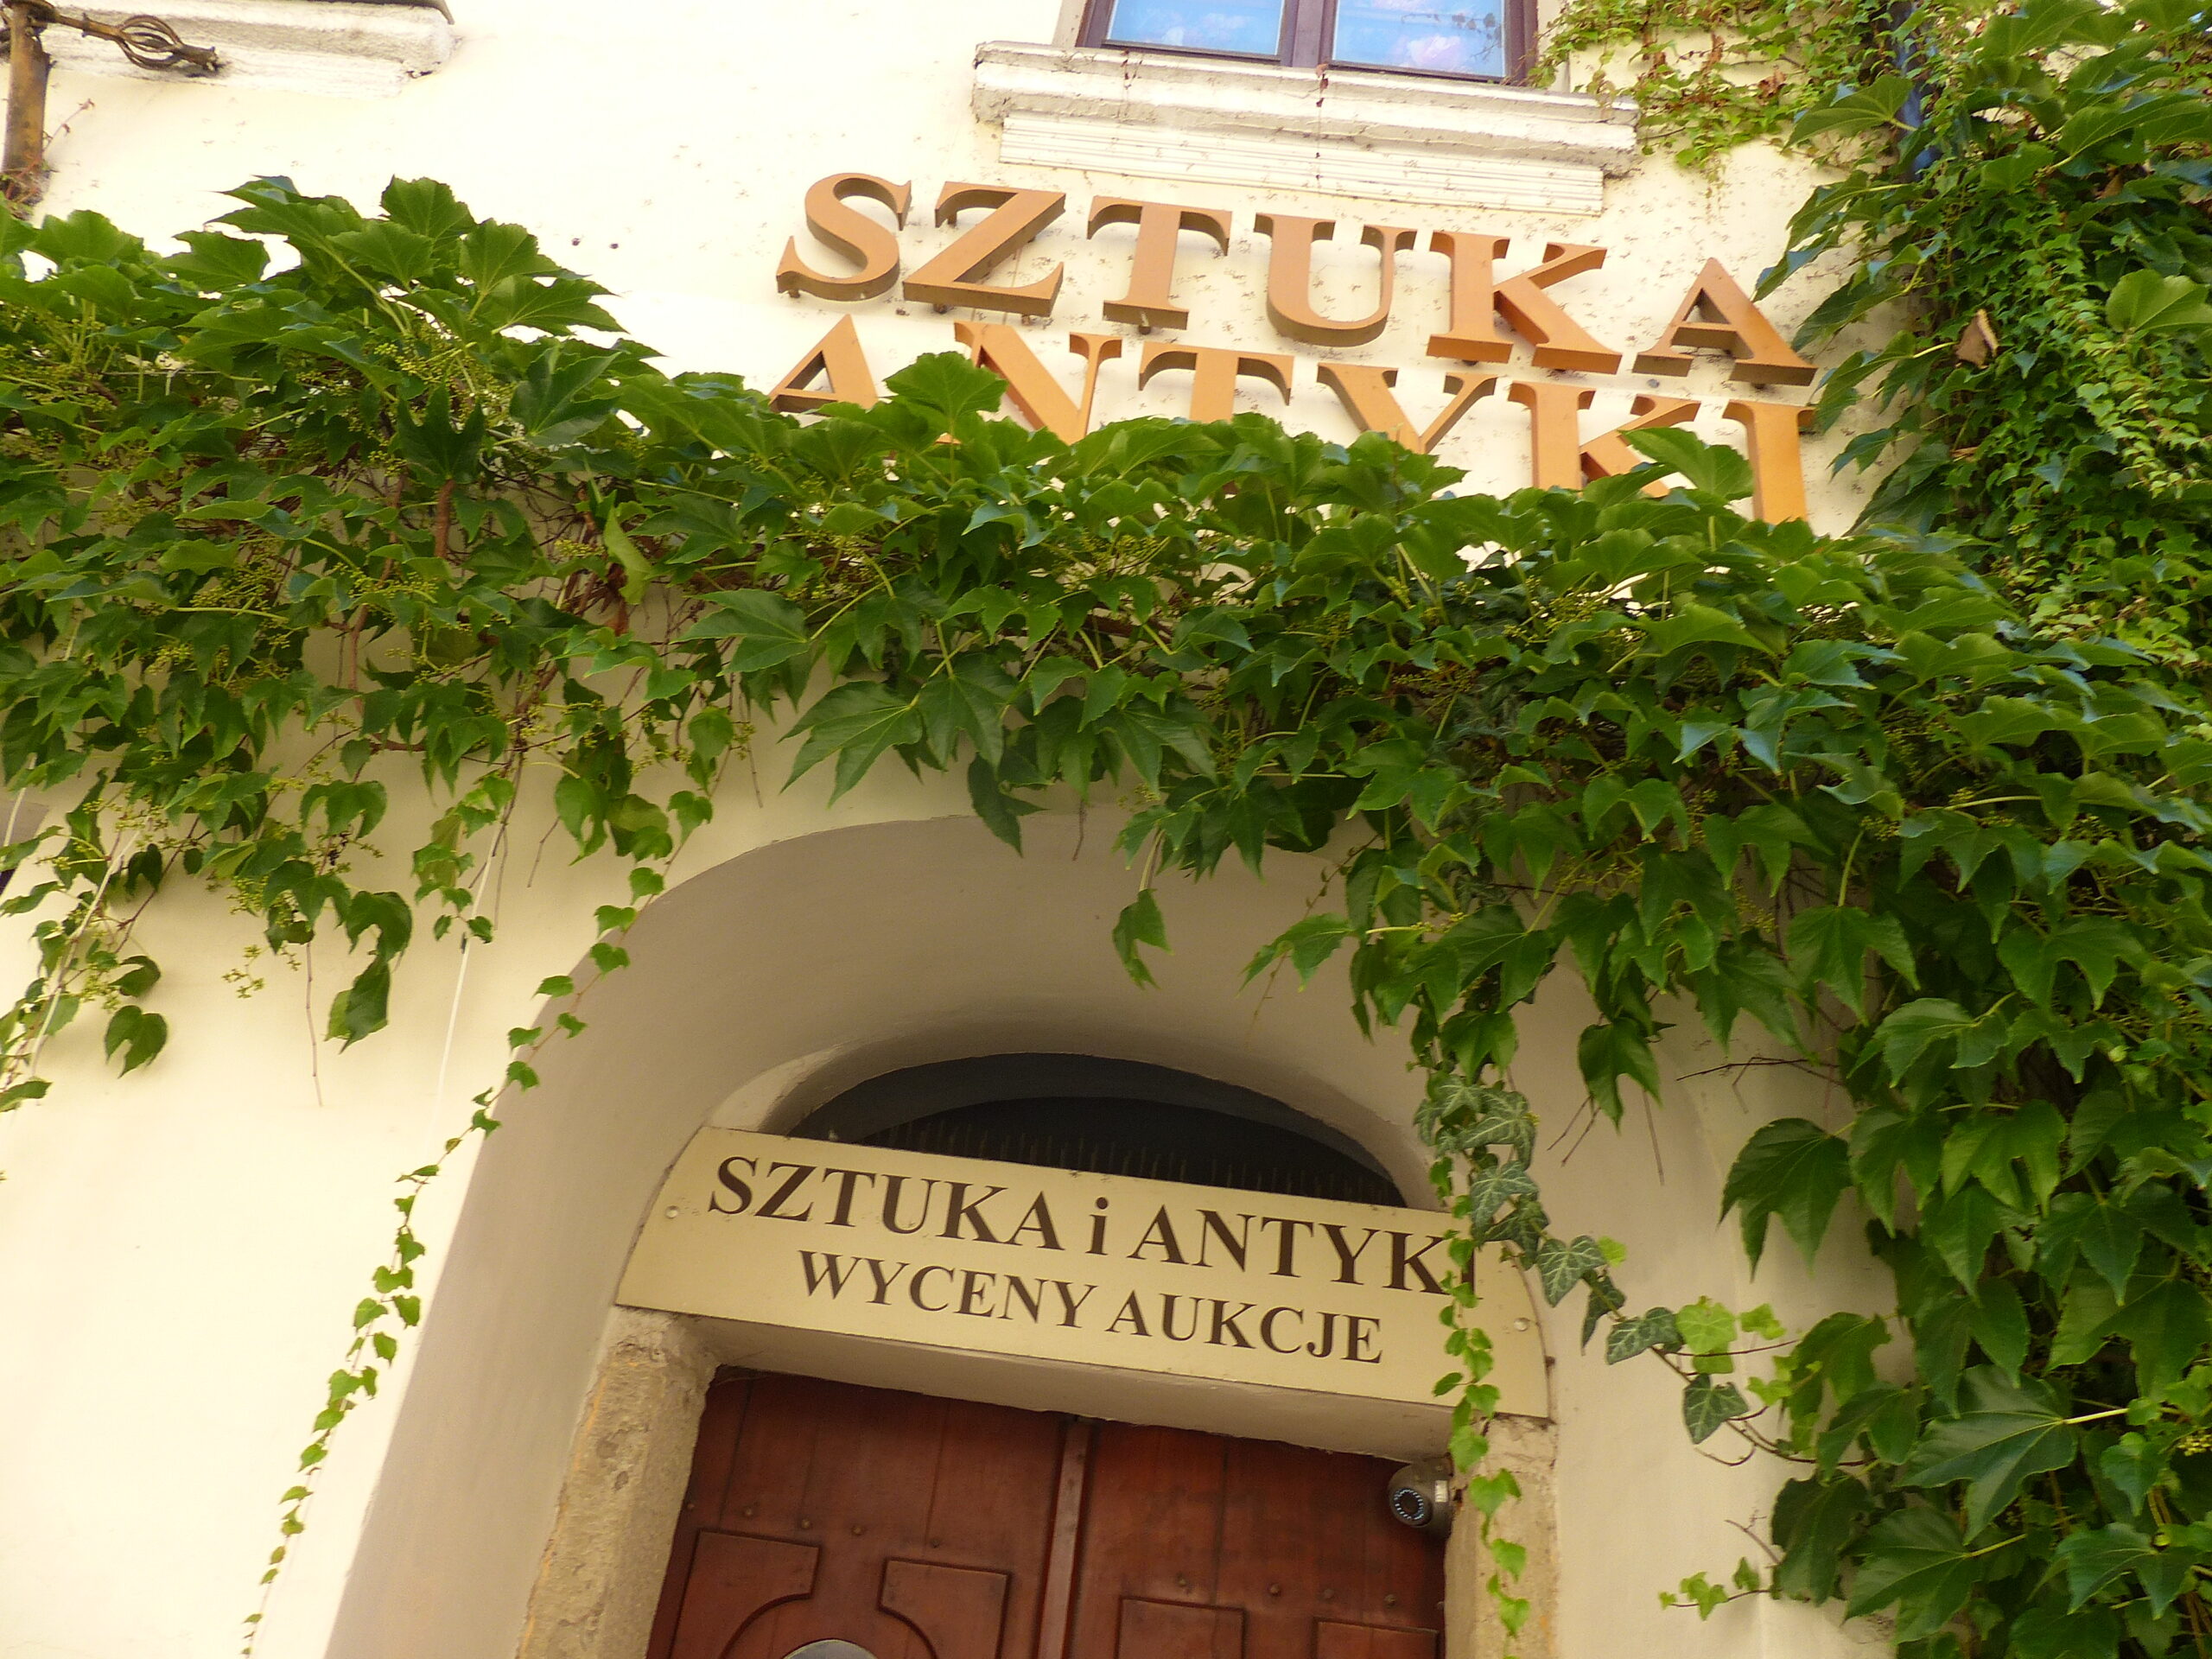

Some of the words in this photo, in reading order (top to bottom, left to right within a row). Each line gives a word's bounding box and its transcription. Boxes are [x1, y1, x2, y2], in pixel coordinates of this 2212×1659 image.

[776, 172, 1819, 387] SZTUKA
[768, 314, 1819, 522] ANTYKI
[707, 1155, 1065, 1250] SZTUKA
[1084, 1196, 1109, 1255] i
[798, 1249, 1098, 1329] WYCENY
[1104, 1289, 1382, 1364] AUKCJE
